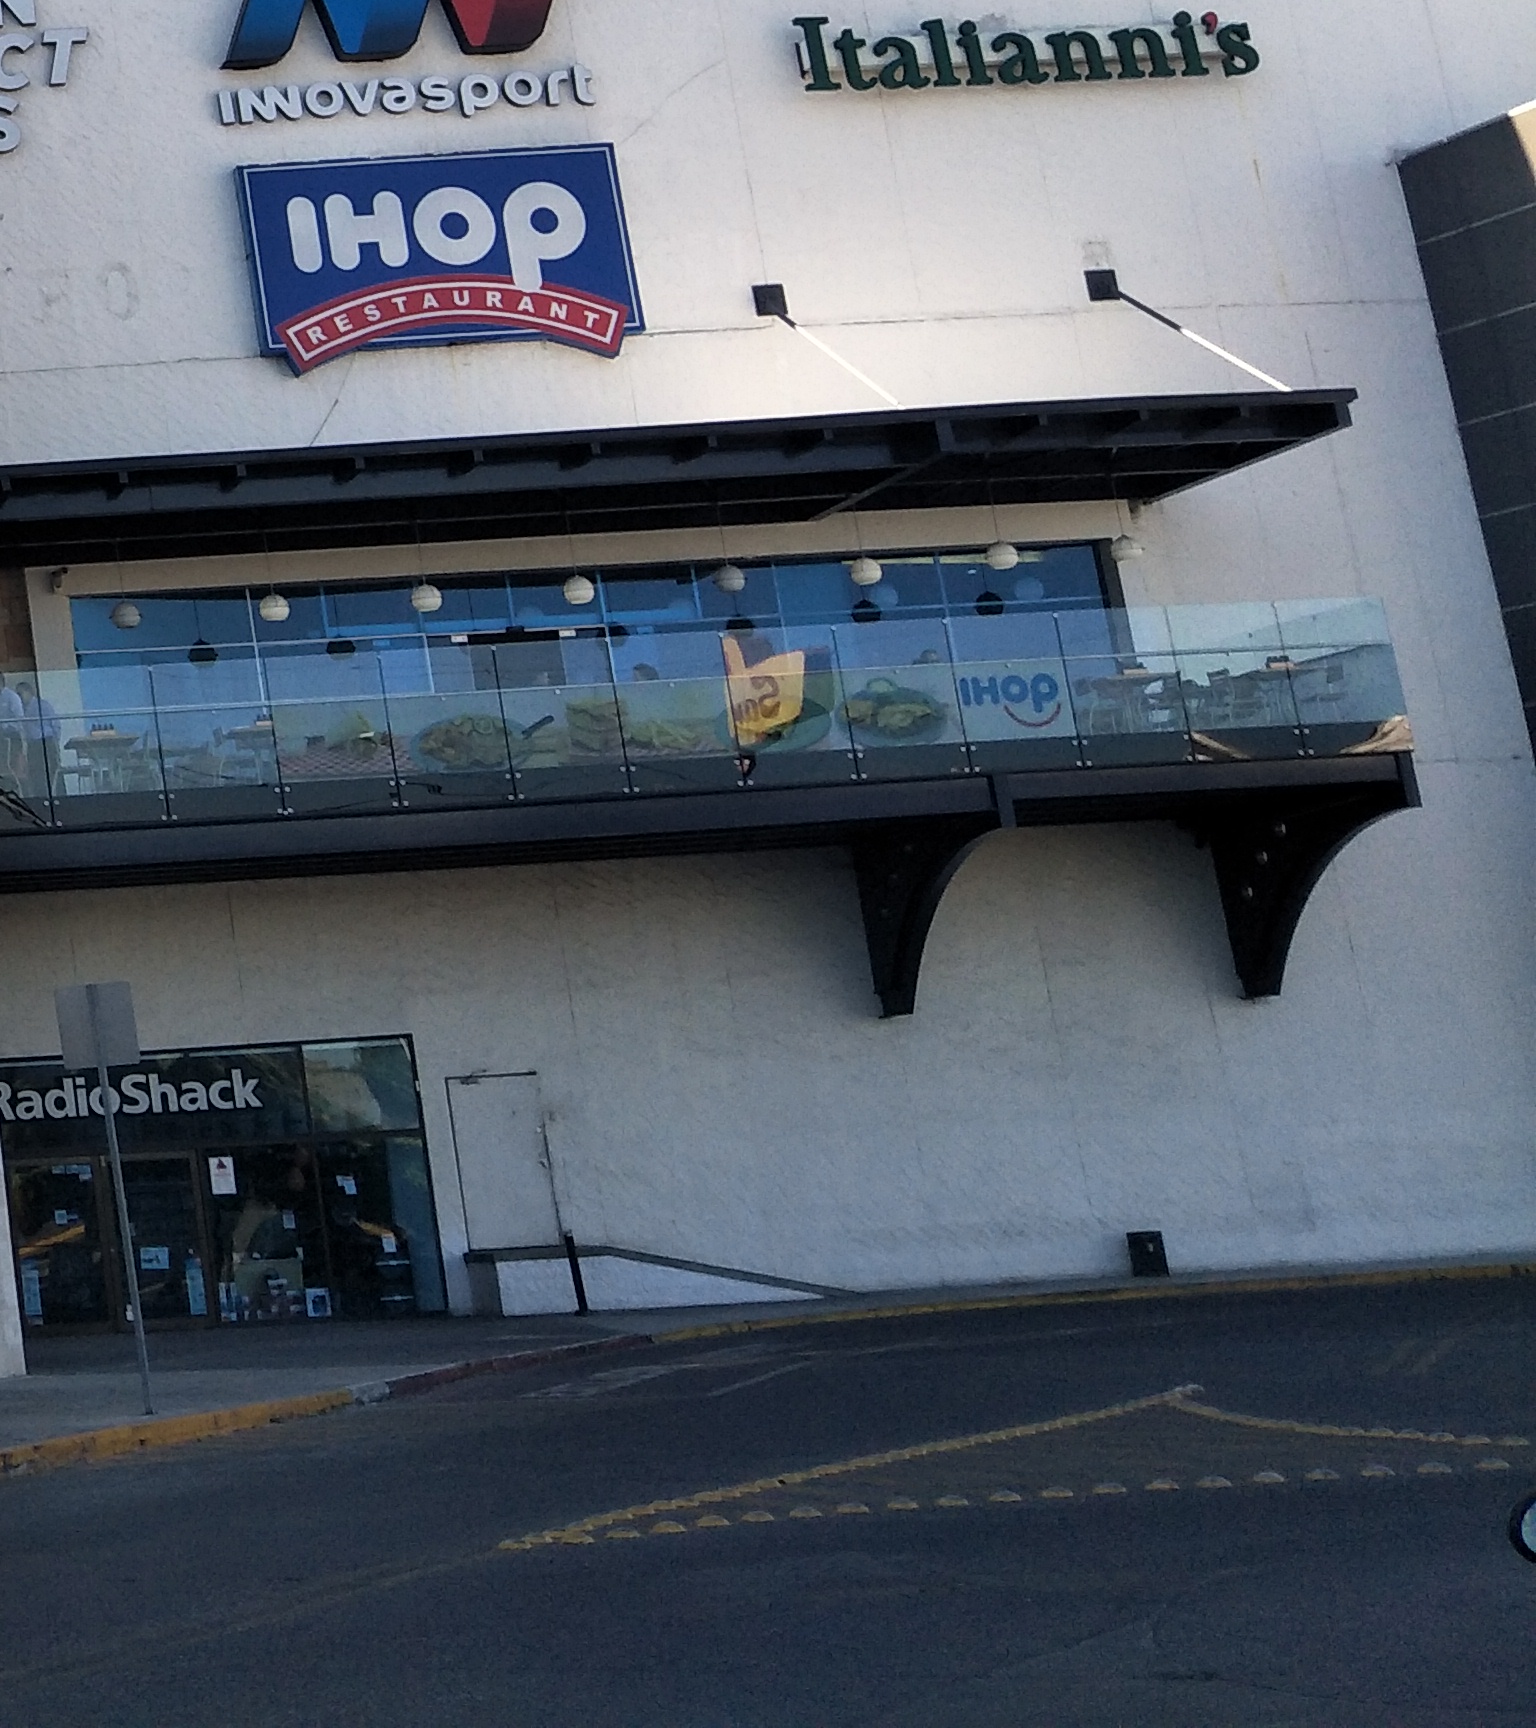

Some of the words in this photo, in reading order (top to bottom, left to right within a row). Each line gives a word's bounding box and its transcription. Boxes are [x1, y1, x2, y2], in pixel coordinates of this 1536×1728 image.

[792, 10, 1261, 92] Italianni's
[286, 181, 588, 293] IHOP
[306, 288, 600, 346] RESTAURANT
[959, 673, 1058, 713] IHOP
